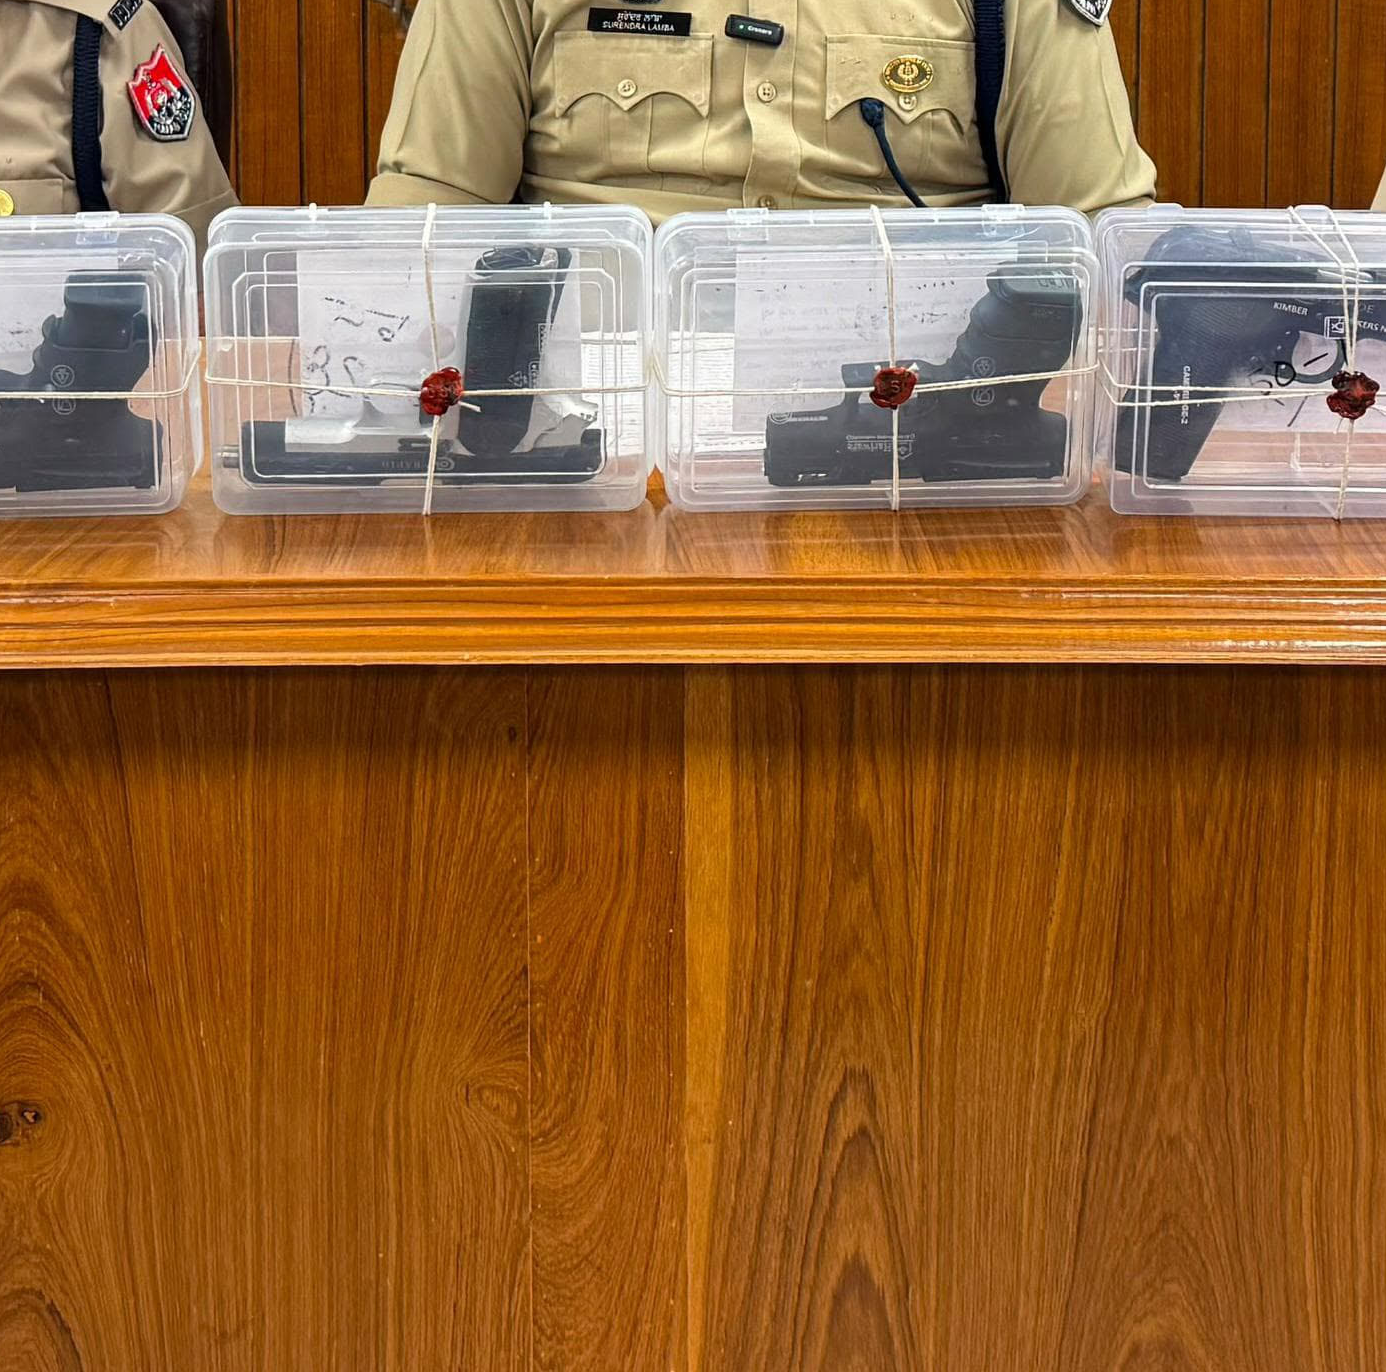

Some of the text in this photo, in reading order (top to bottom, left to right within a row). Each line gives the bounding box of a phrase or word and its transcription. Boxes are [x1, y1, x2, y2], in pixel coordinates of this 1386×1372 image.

[602, 20, 675, 32] SURENDRA LAMBA
[1273, 301, 1309, 316] KIMBER
